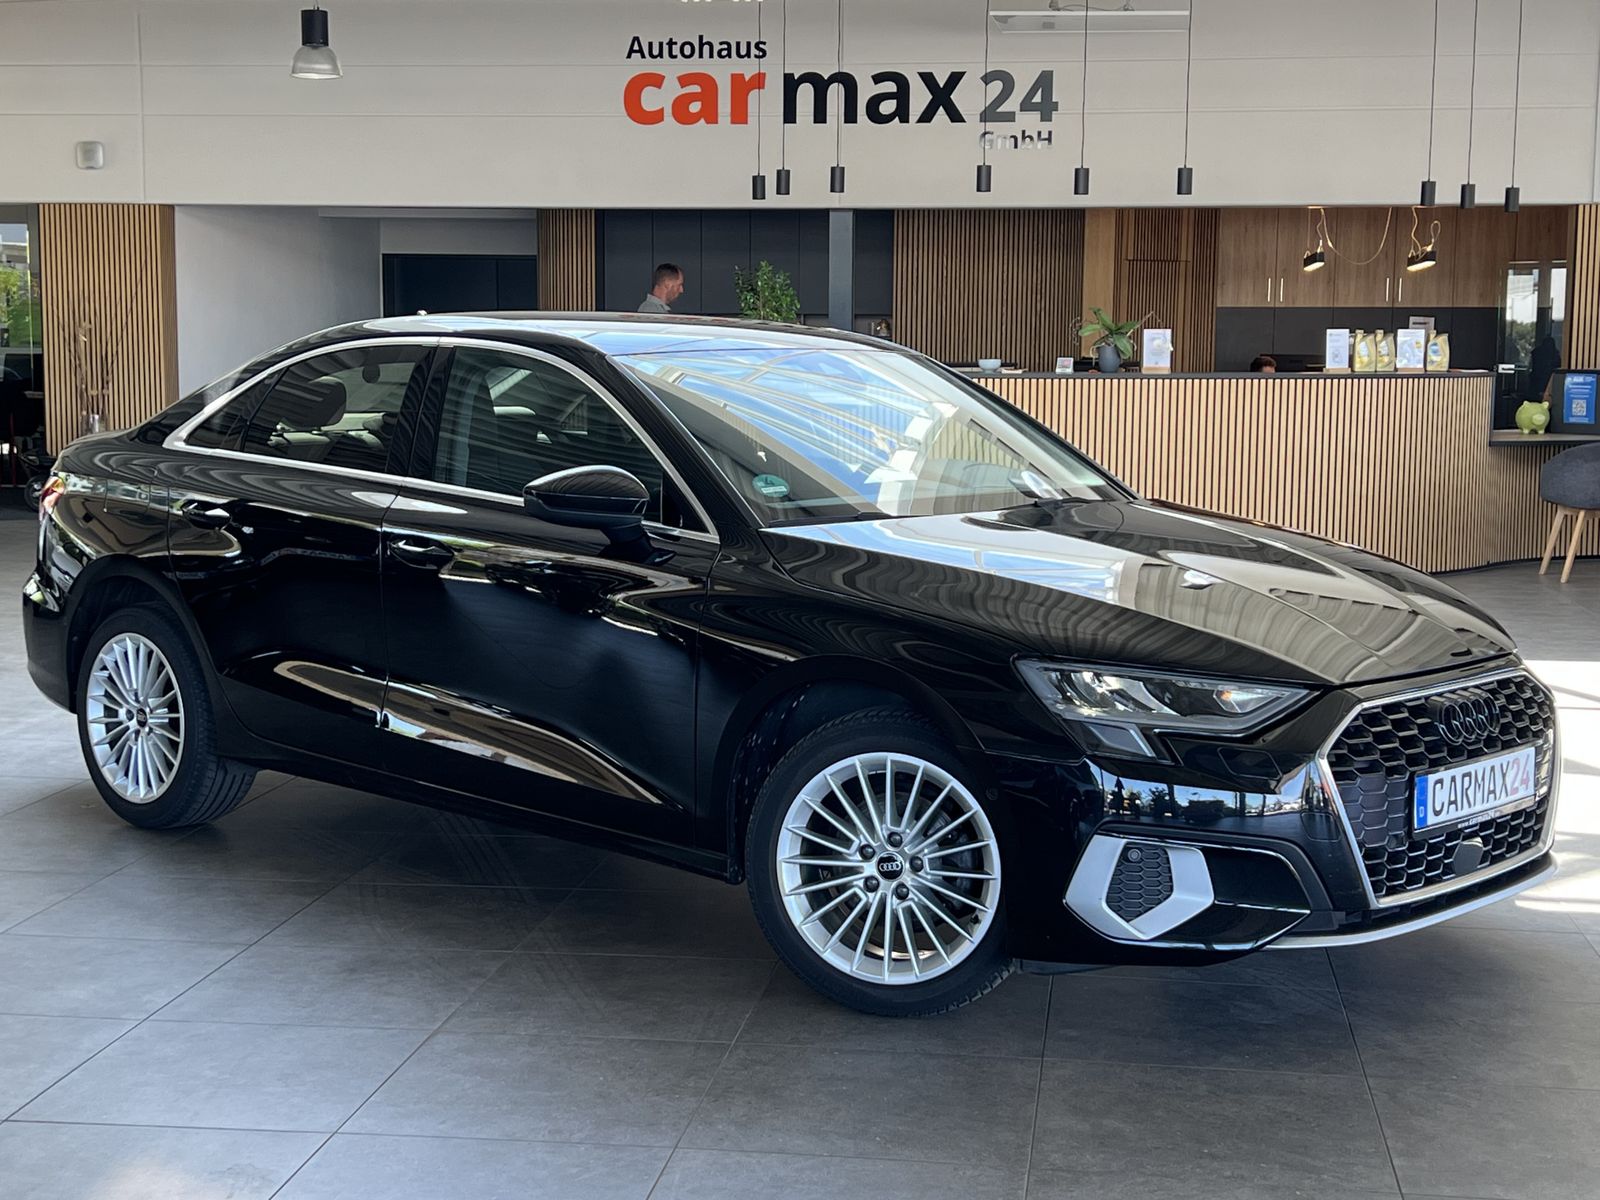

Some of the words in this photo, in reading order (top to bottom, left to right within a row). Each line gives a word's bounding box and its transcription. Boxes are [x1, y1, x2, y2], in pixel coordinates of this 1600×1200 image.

[626, 35, 767, 60] Autohaus
[979, 129, 1053, 150] GmbH
[1432, 754, 1530, 817] CARMAX24
